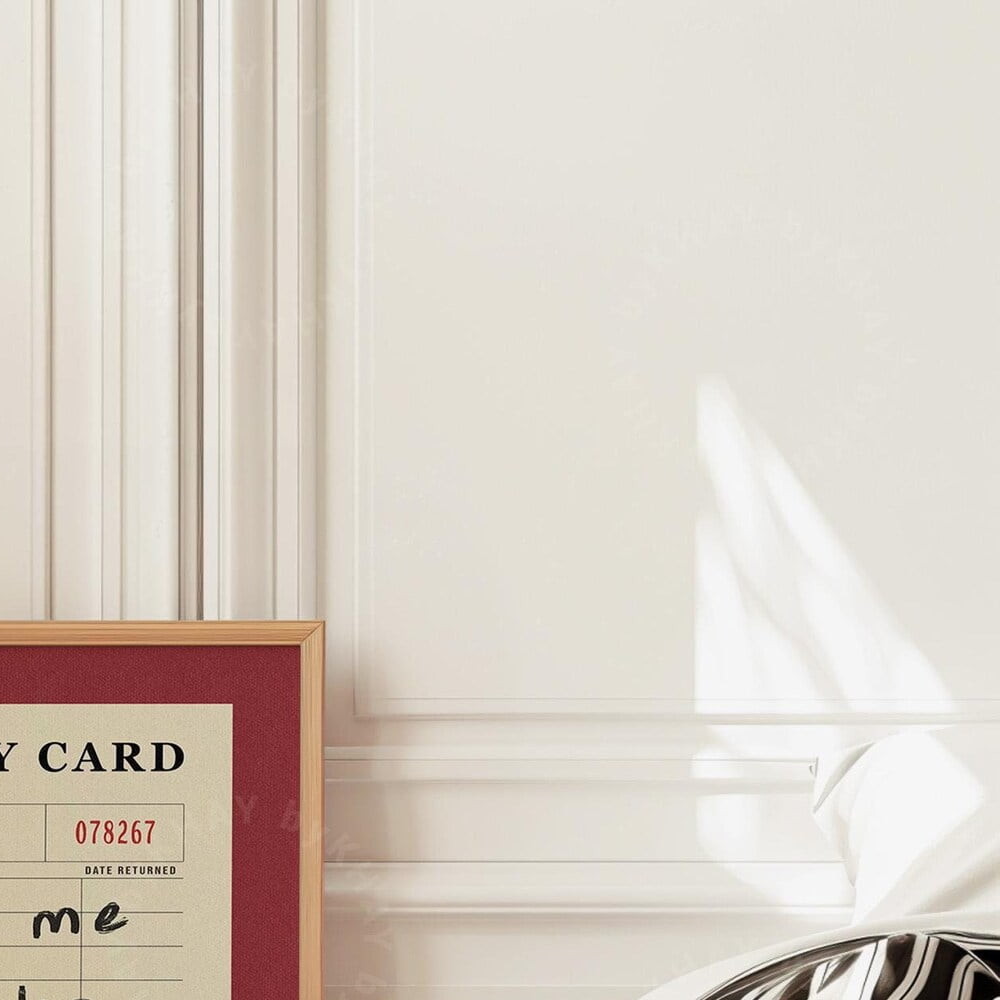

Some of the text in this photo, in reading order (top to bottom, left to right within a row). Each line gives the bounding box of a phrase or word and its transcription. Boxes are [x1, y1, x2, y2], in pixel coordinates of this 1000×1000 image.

[38, 742, 185, 772] CARD
[75, 820, 156, 845] 078267
[85, 866, 176, 875] DATE RETURNED
[33, 902, 129, 939] me
